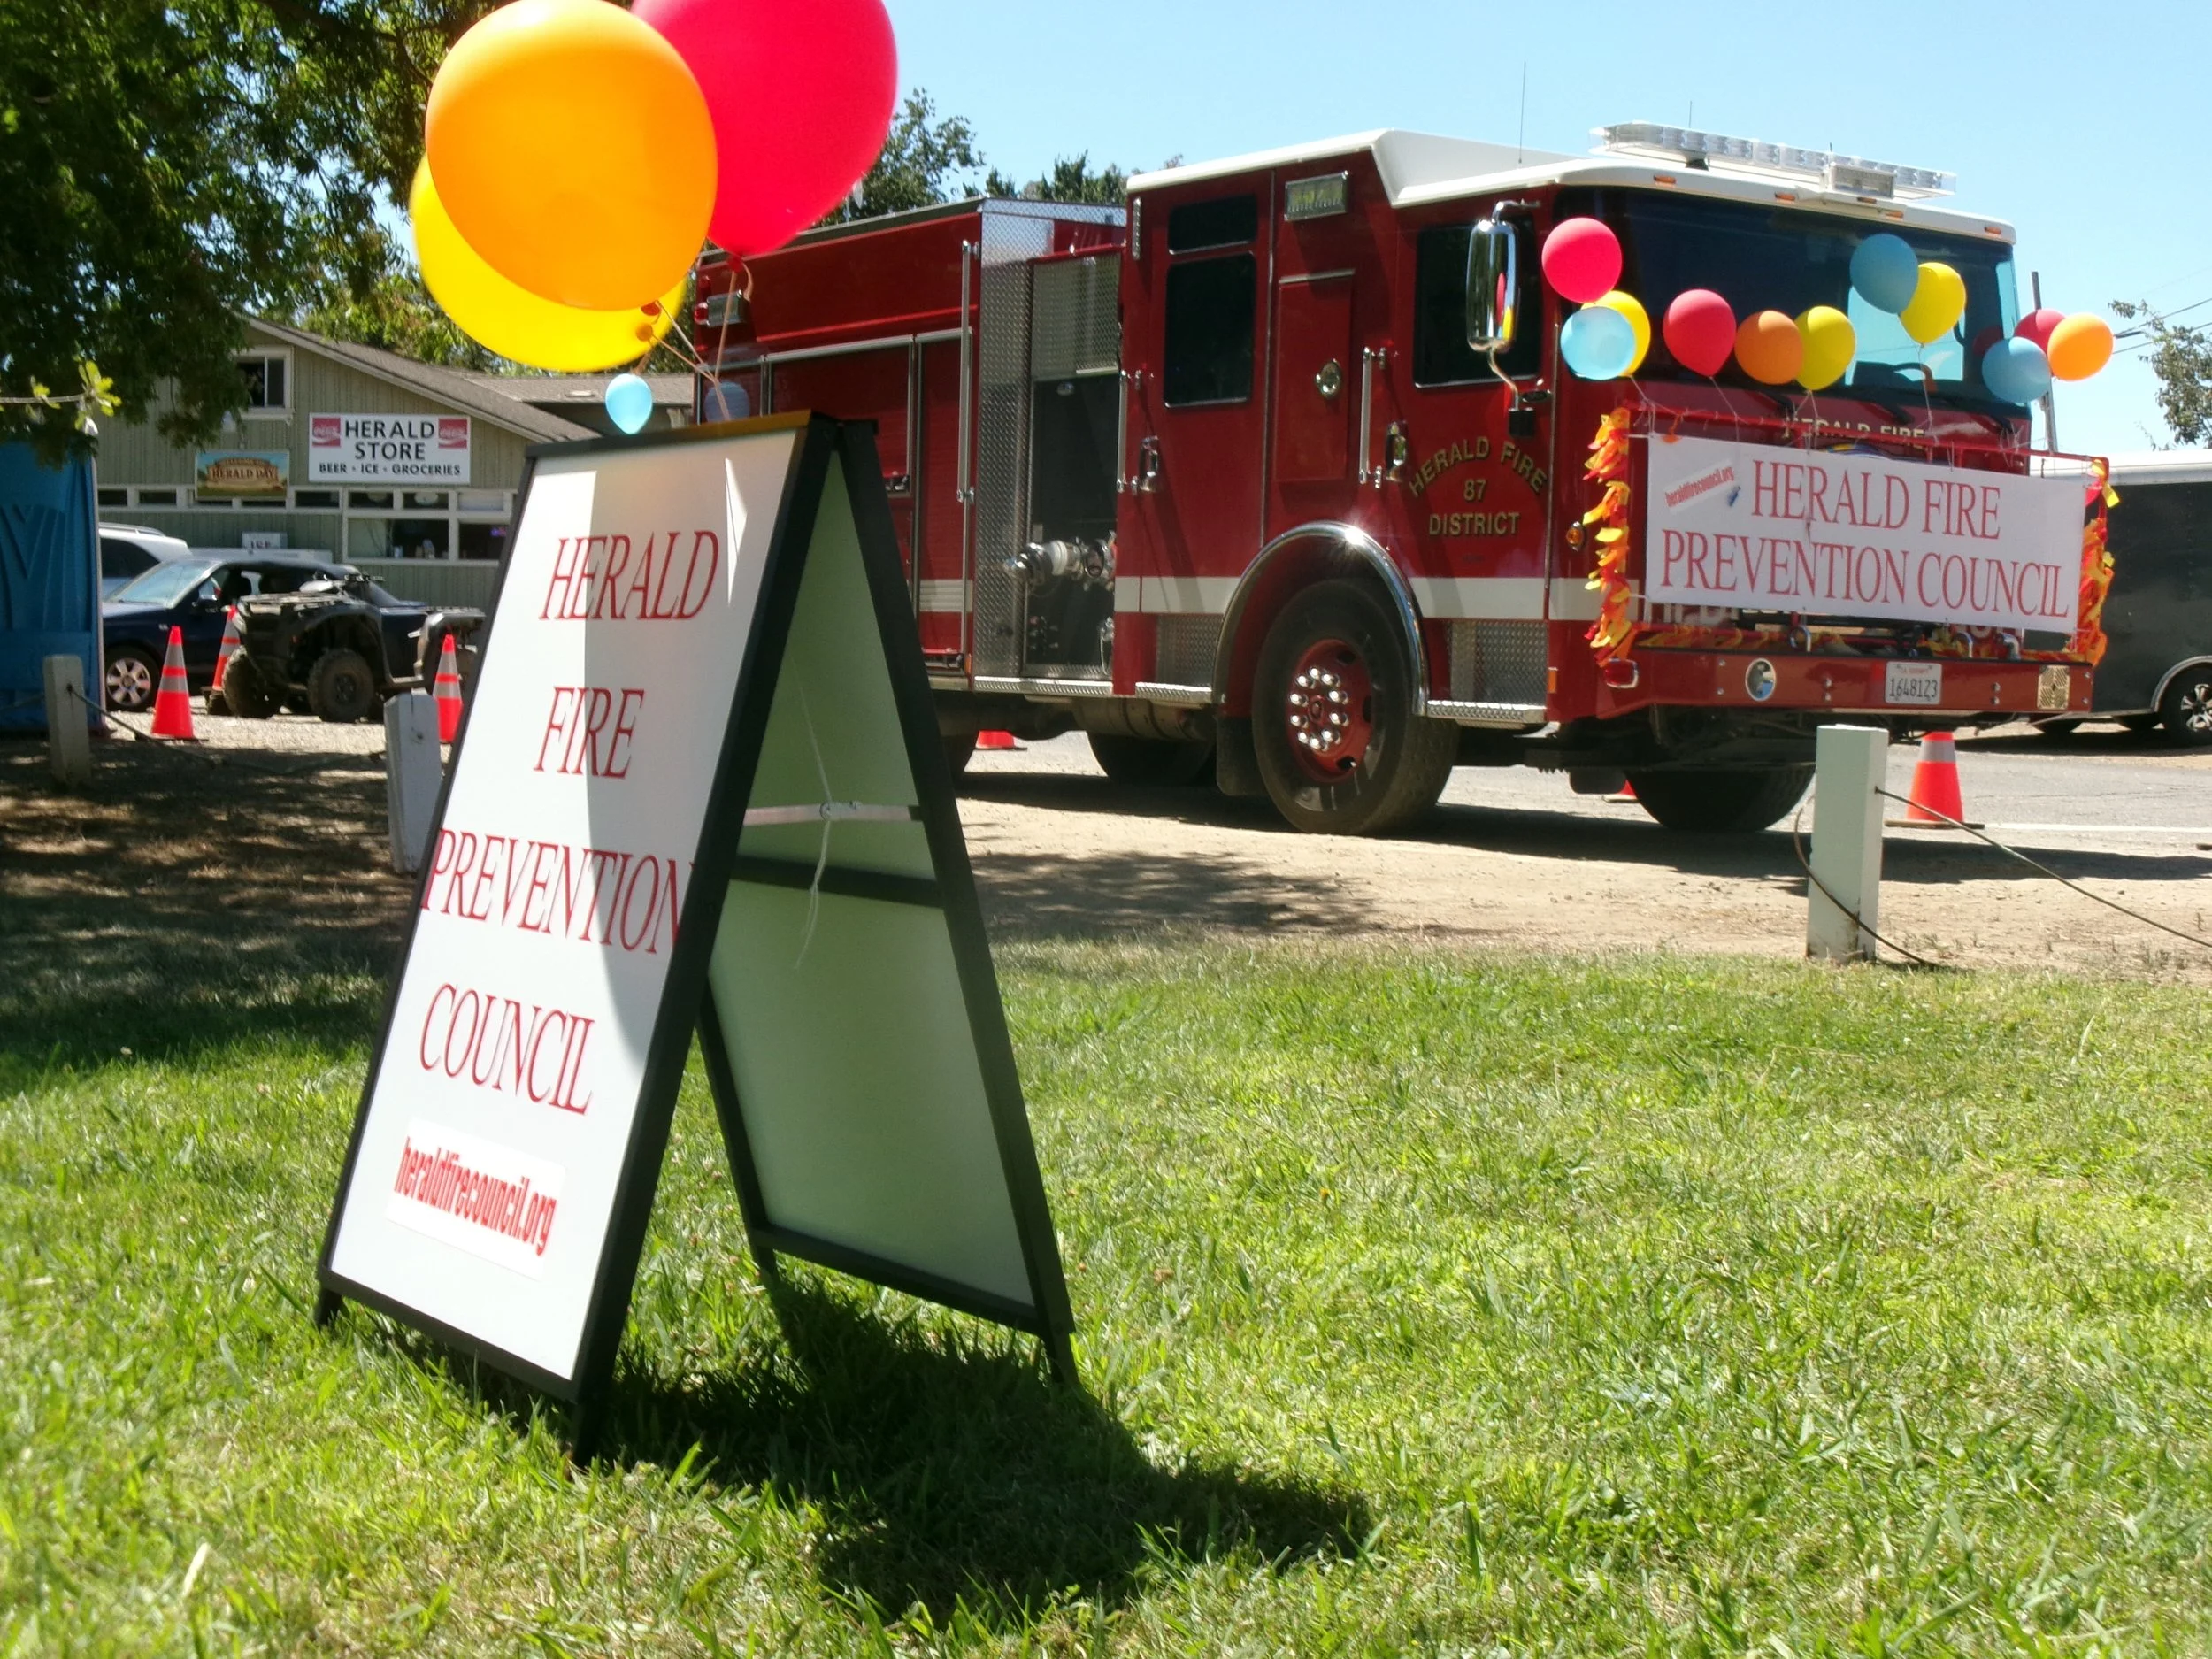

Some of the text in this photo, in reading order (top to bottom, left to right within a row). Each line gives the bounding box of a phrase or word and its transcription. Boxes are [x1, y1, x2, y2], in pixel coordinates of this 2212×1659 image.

[344, 419, 435, 439] HERALD
[354, 442, 426, 461] STORE
[212, 468, 253, 479] HERALD
[319, 463, 461, 475] BEER ICE GROCERIES
[1409, 436, 1548, 497] HERALD FIRE
[1463, 479, 1486, 502] 87
[1428, 511, 1520, 536] DISTRICT
[1751, 459, 2001, 540] HERALD FIRE
[538, 530, 718, 620] HERALD
[1660, 528, 2070, 618] PREVENTION COUNCIL
[1889, 678, 1938, 698] 1648123
[533, 686, 645, 780] FIRE
[420, 827, 696, 955] PREVENTION
[419, 982, 595, 1115] COUNCIL
[394, 1136, 557, 1256] heraldfirecouncil.org
